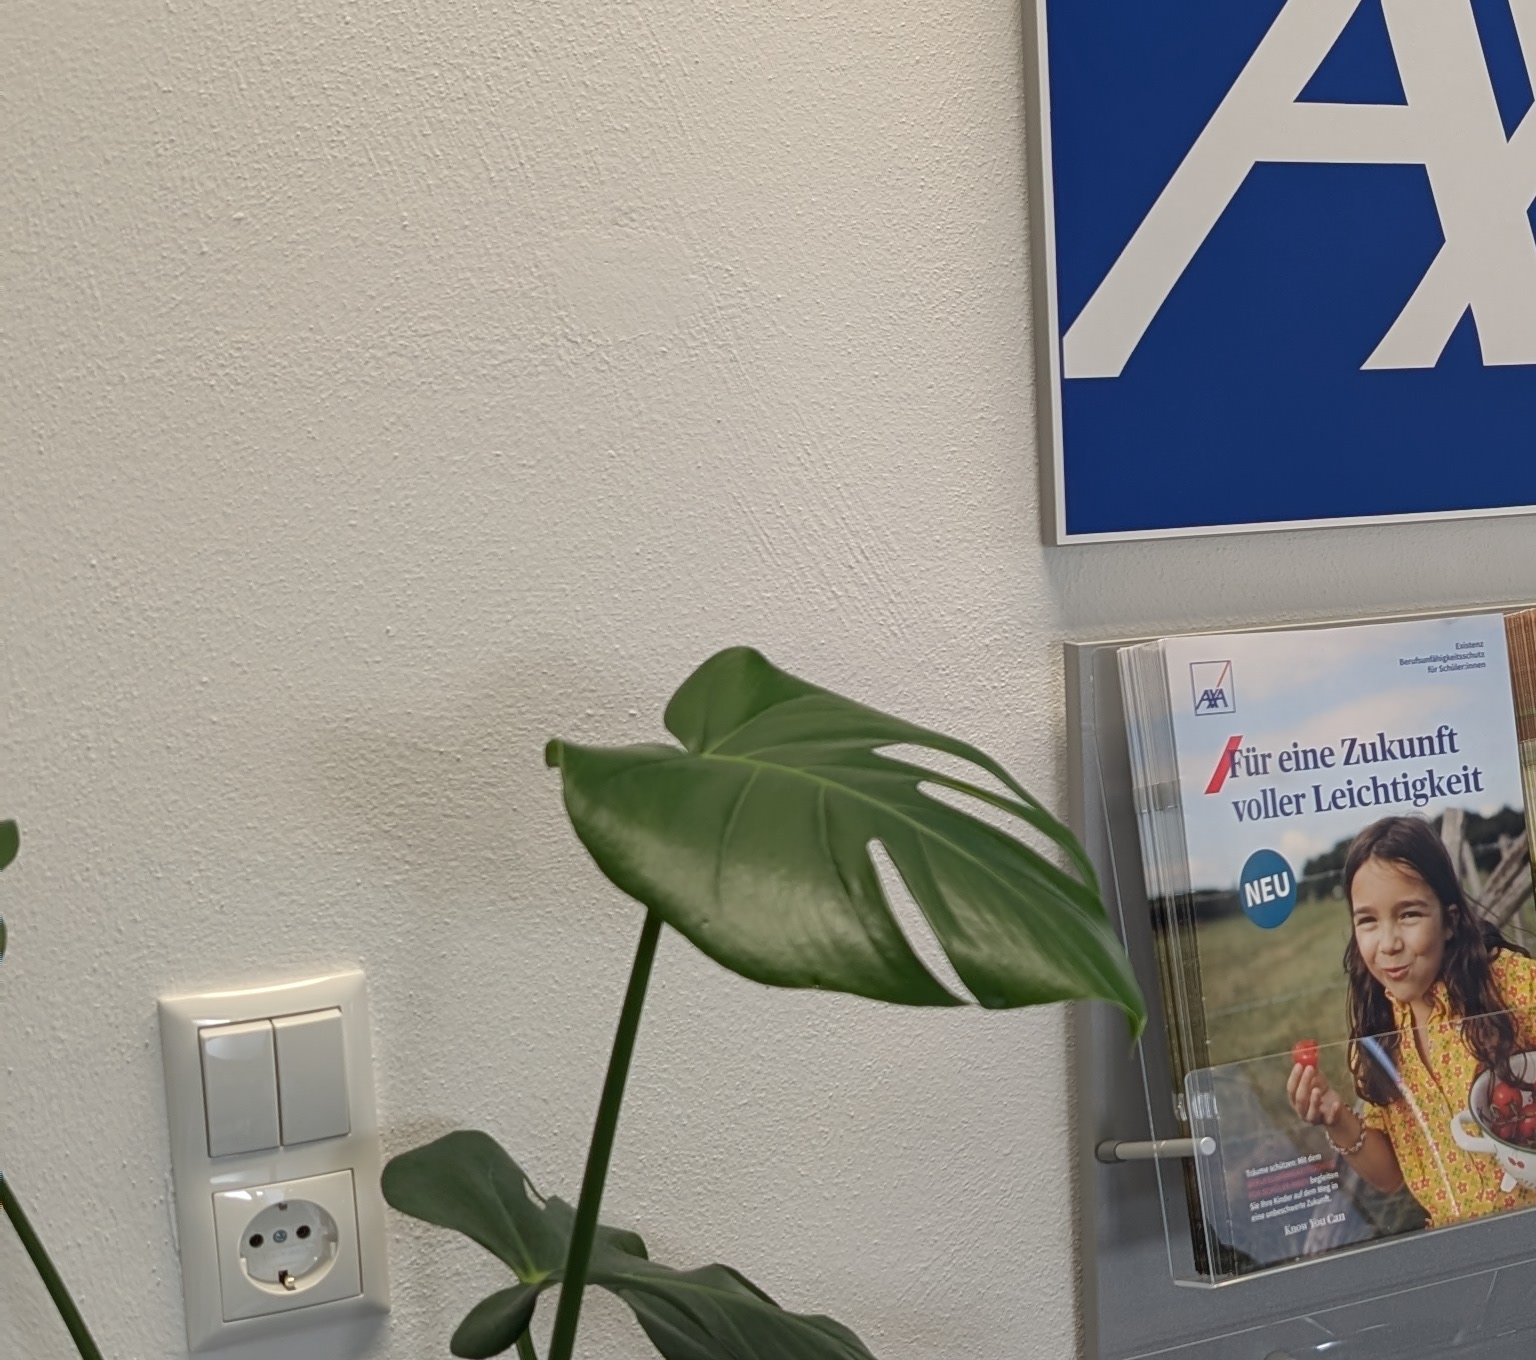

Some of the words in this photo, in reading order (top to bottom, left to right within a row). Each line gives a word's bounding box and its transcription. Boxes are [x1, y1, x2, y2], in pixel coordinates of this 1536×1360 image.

[1455, 641, 1484, 650] Existenz
[1399, 651, 1486, 666] Berufsunfähigkeitsschutz
[1427, 665, 1438, 674] für
[1229, 746, 1273, 779] Für
[1278, 741, 1335, 773] eine
[1340, 723, 1460, 768] Zukunft
[1231, 787, 1306, 823] voller
[1312, 764, 1485, 815] Leichtigkeit
[1243, 870, 1291, 908] NEU
[1283, 1222, 1308, 1237] Know
[1308, 1216, 1326, 1229] You
[1326, 1212, 1346, 1224] Can
